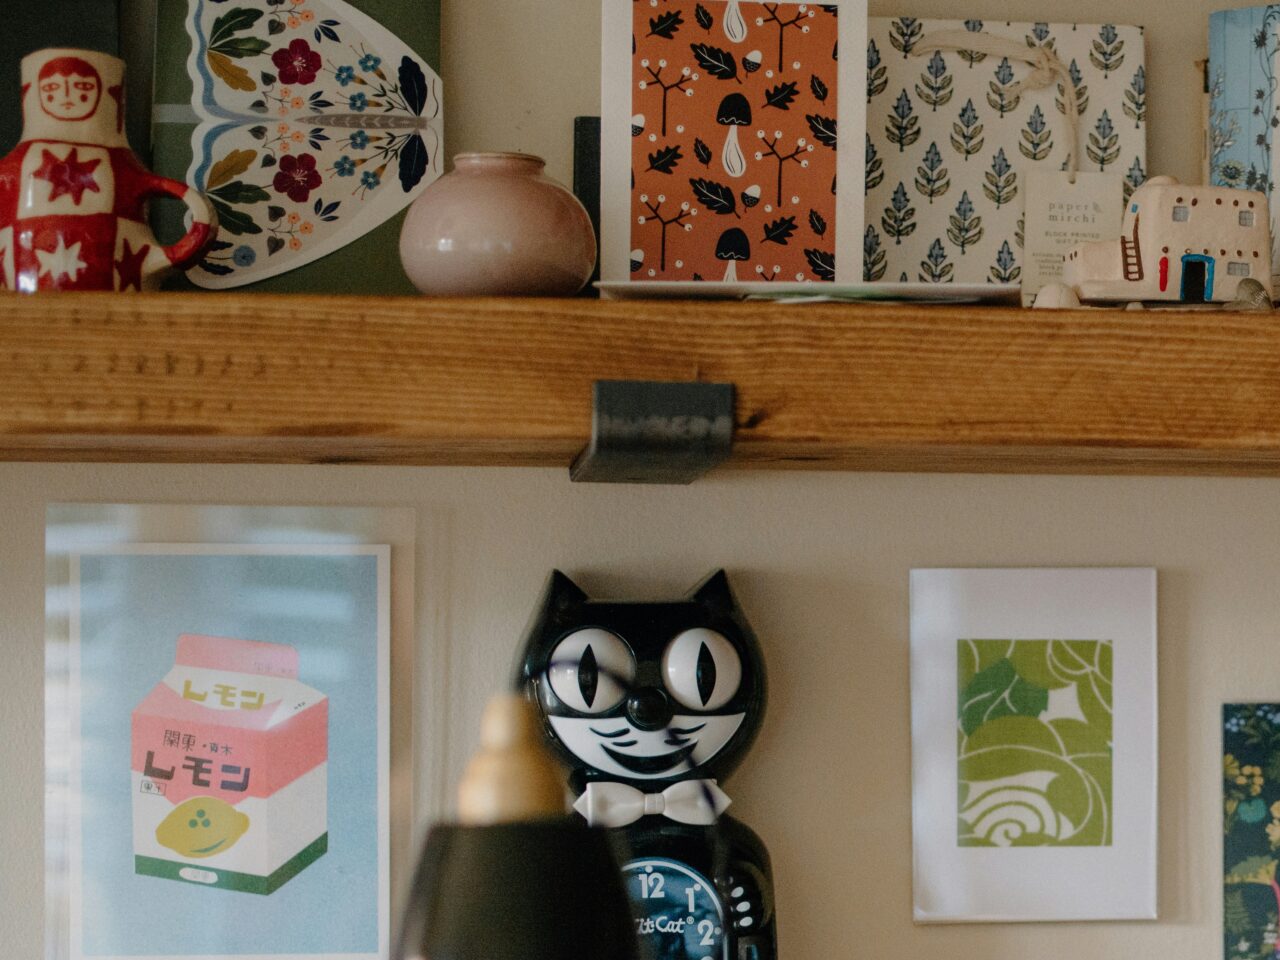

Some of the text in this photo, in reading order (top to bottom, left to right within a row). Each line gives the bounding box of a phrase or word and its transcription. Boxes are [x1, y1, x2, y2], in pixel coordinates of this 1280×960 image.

[1048, 203, 1089, 212] paper
[1048, 213, 1096, 223] mirchi
[181, 680, 265, 711] レモン
[143, 750, 251, 793] レモン
[638, 872, 665, 899] 12
[685, 887, 695, 913] 1
[697, 919, 714, 946] 2
